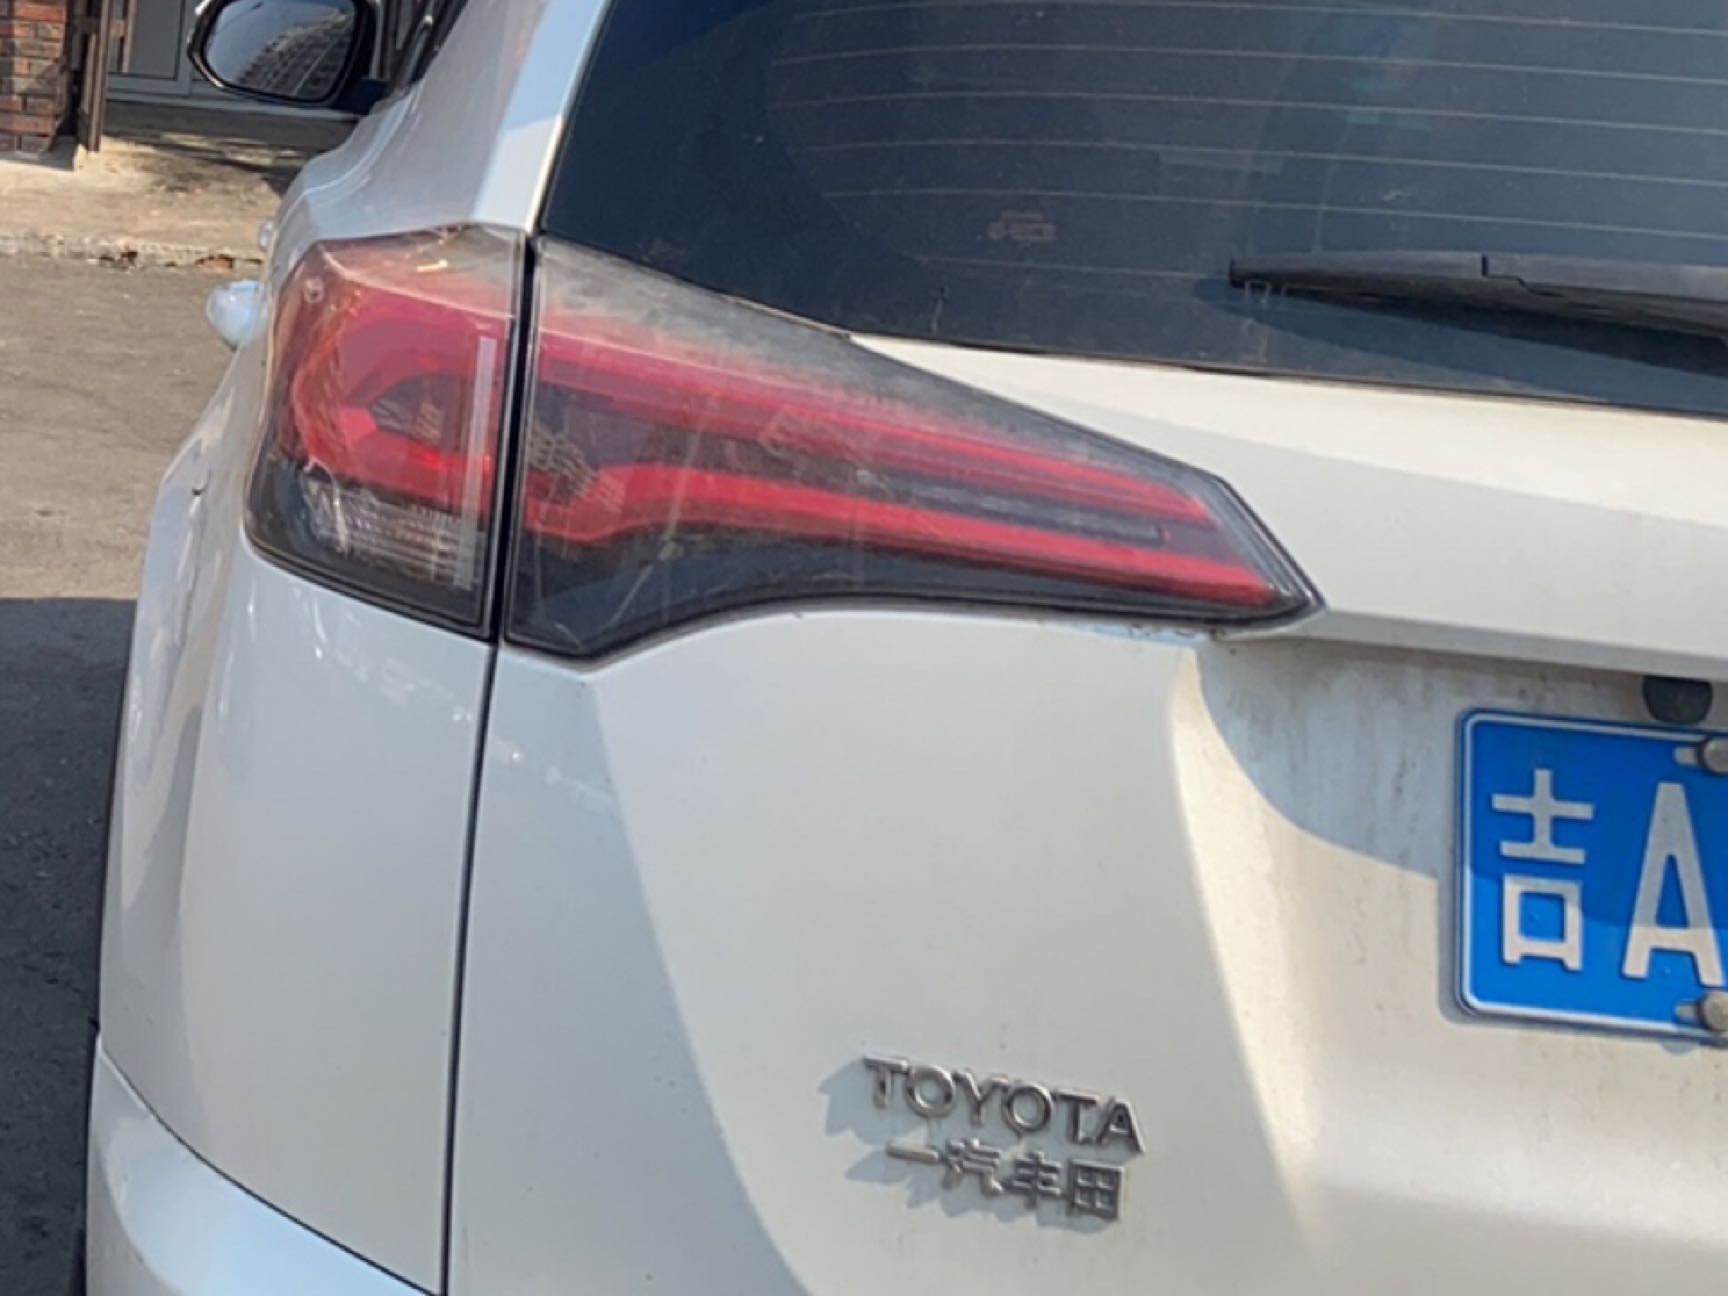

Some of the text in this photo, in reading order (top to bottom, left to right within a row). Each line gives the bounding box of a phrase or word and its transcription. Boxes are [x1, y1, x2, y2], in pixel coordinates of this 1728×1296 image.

[1491, 768, 1726, 988] 吉A
[862, 1055, 1146, 1156] TOYOTA
[885, 1137, 1124, 1222] 一汽丰田
